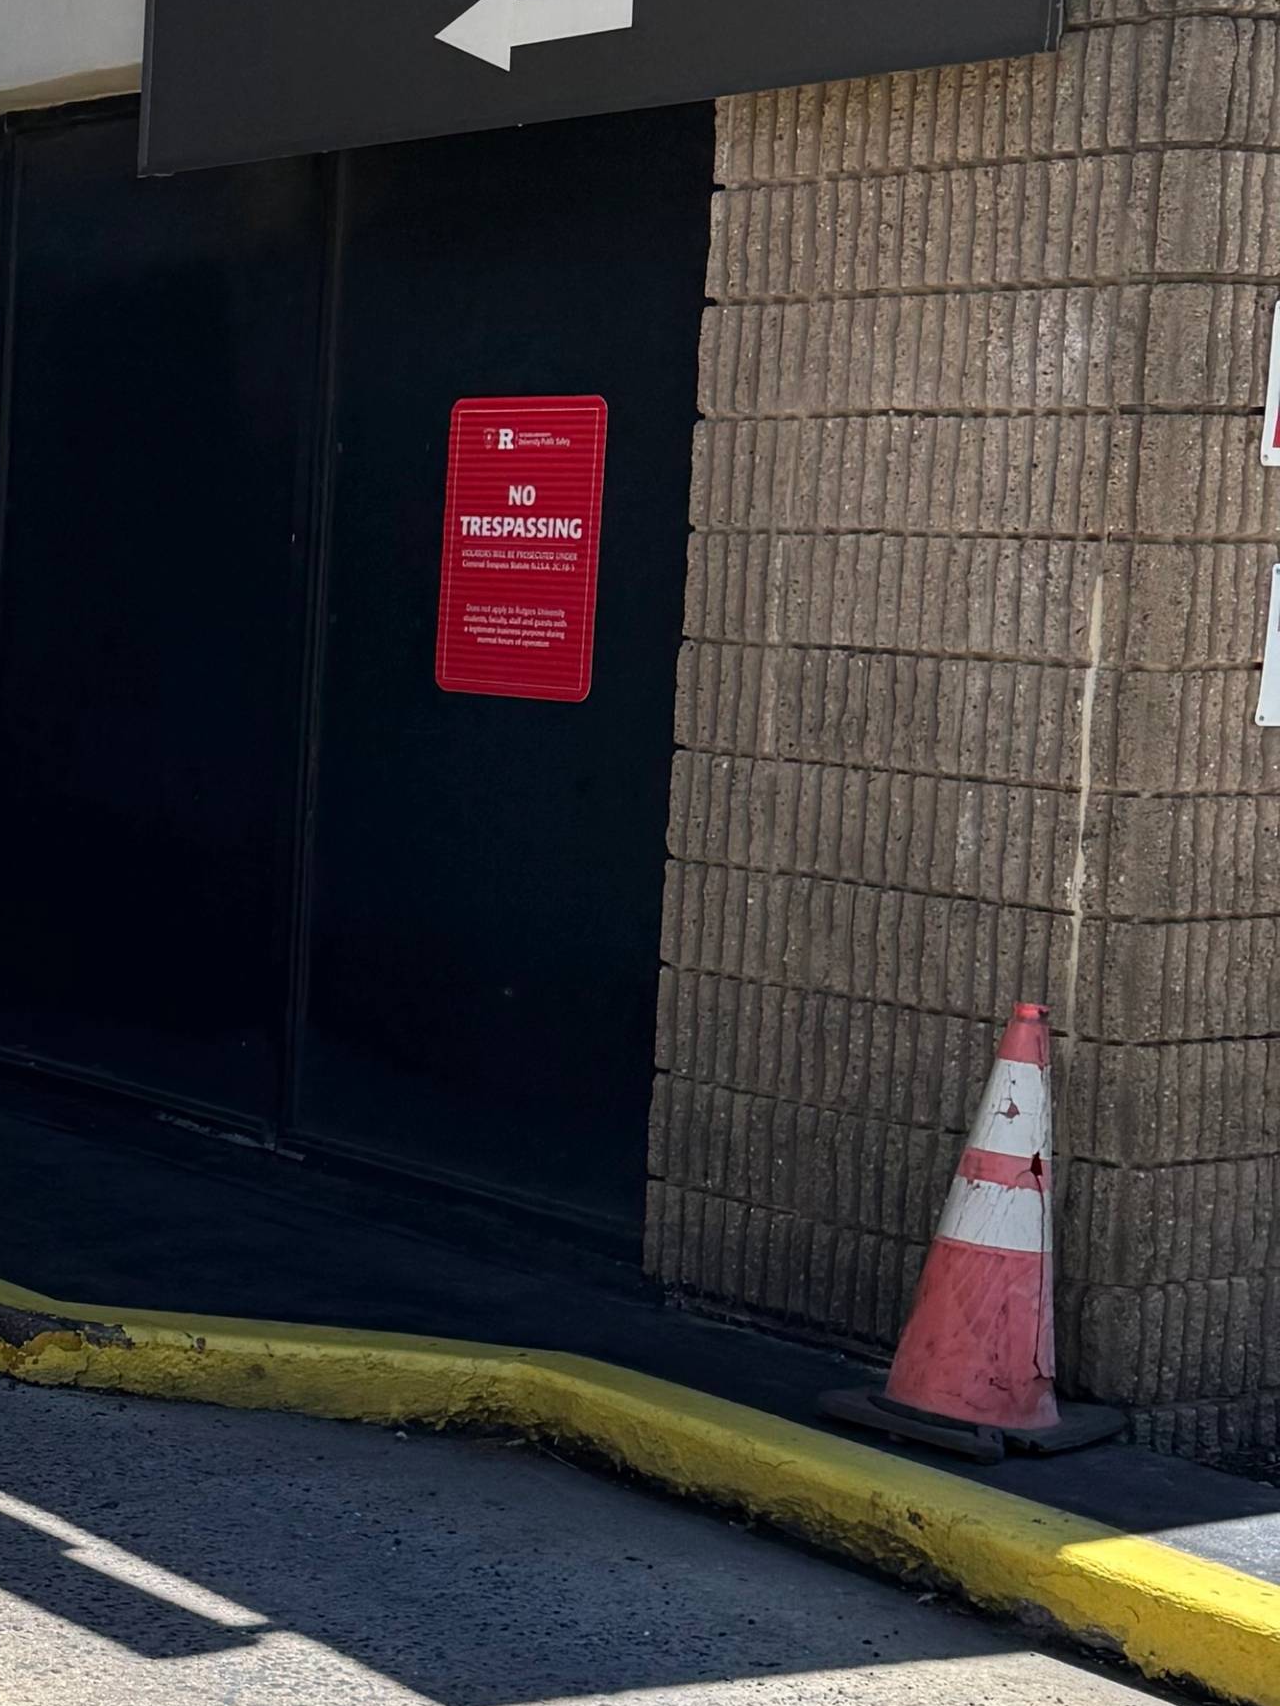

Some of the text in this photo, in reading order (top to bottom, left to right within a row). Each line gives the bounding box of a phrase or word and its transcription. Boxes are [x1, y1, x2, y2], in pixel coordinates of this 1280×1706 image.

[498, 428, 514, 450] R
[508, 485, 536, 506] NO
[460, 516, 582, 539] TRESPASSING
